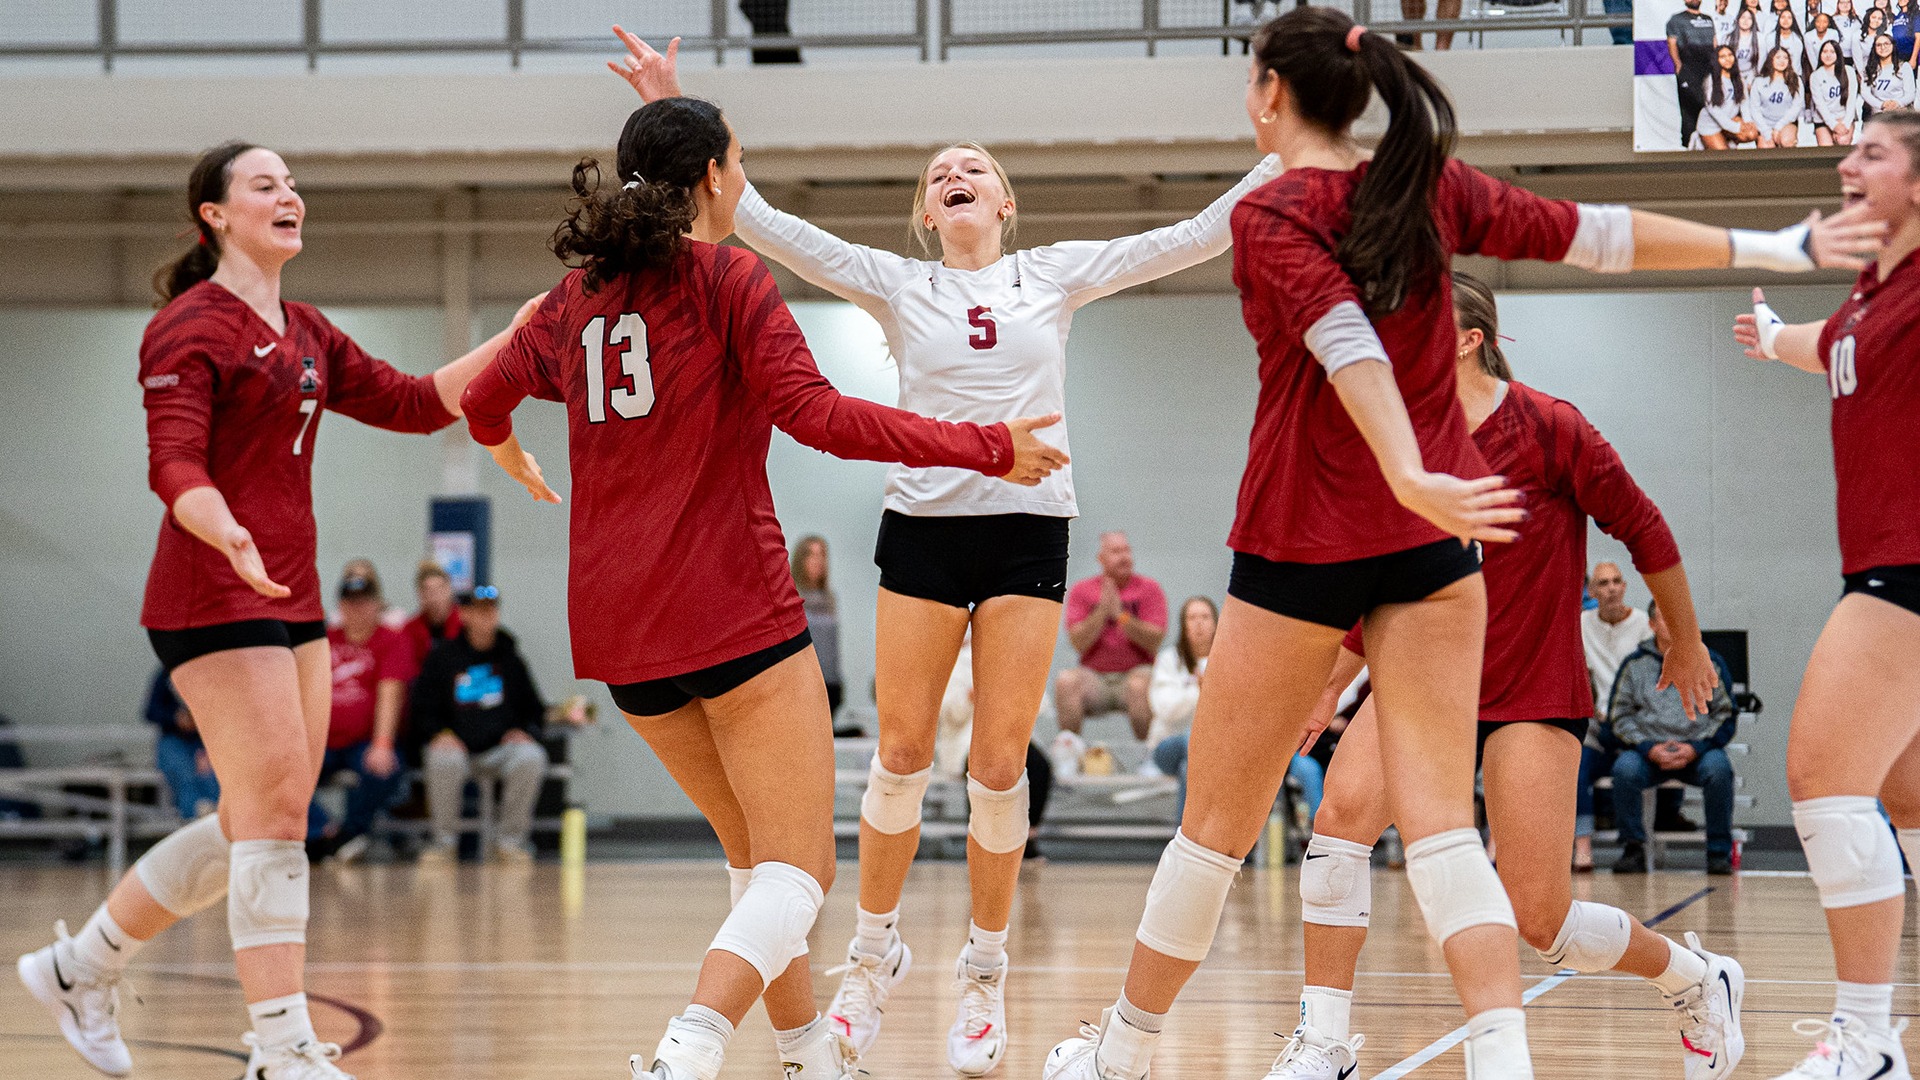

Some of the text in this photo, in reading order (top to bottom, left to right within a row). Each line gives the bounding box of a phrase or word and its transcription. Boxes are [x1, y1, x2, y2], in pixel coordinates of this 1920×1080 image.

[1769, 91, 1784, 104] 48
[1829, 85, 1841, 99] 60
[1877, 79, 1891, 91] 77
[967, 305, 998, 351] 5
[580, 312, 656, 424] 13
[1830, 334, 1858, 400] 10
[292, 399, 319, 456] 7
